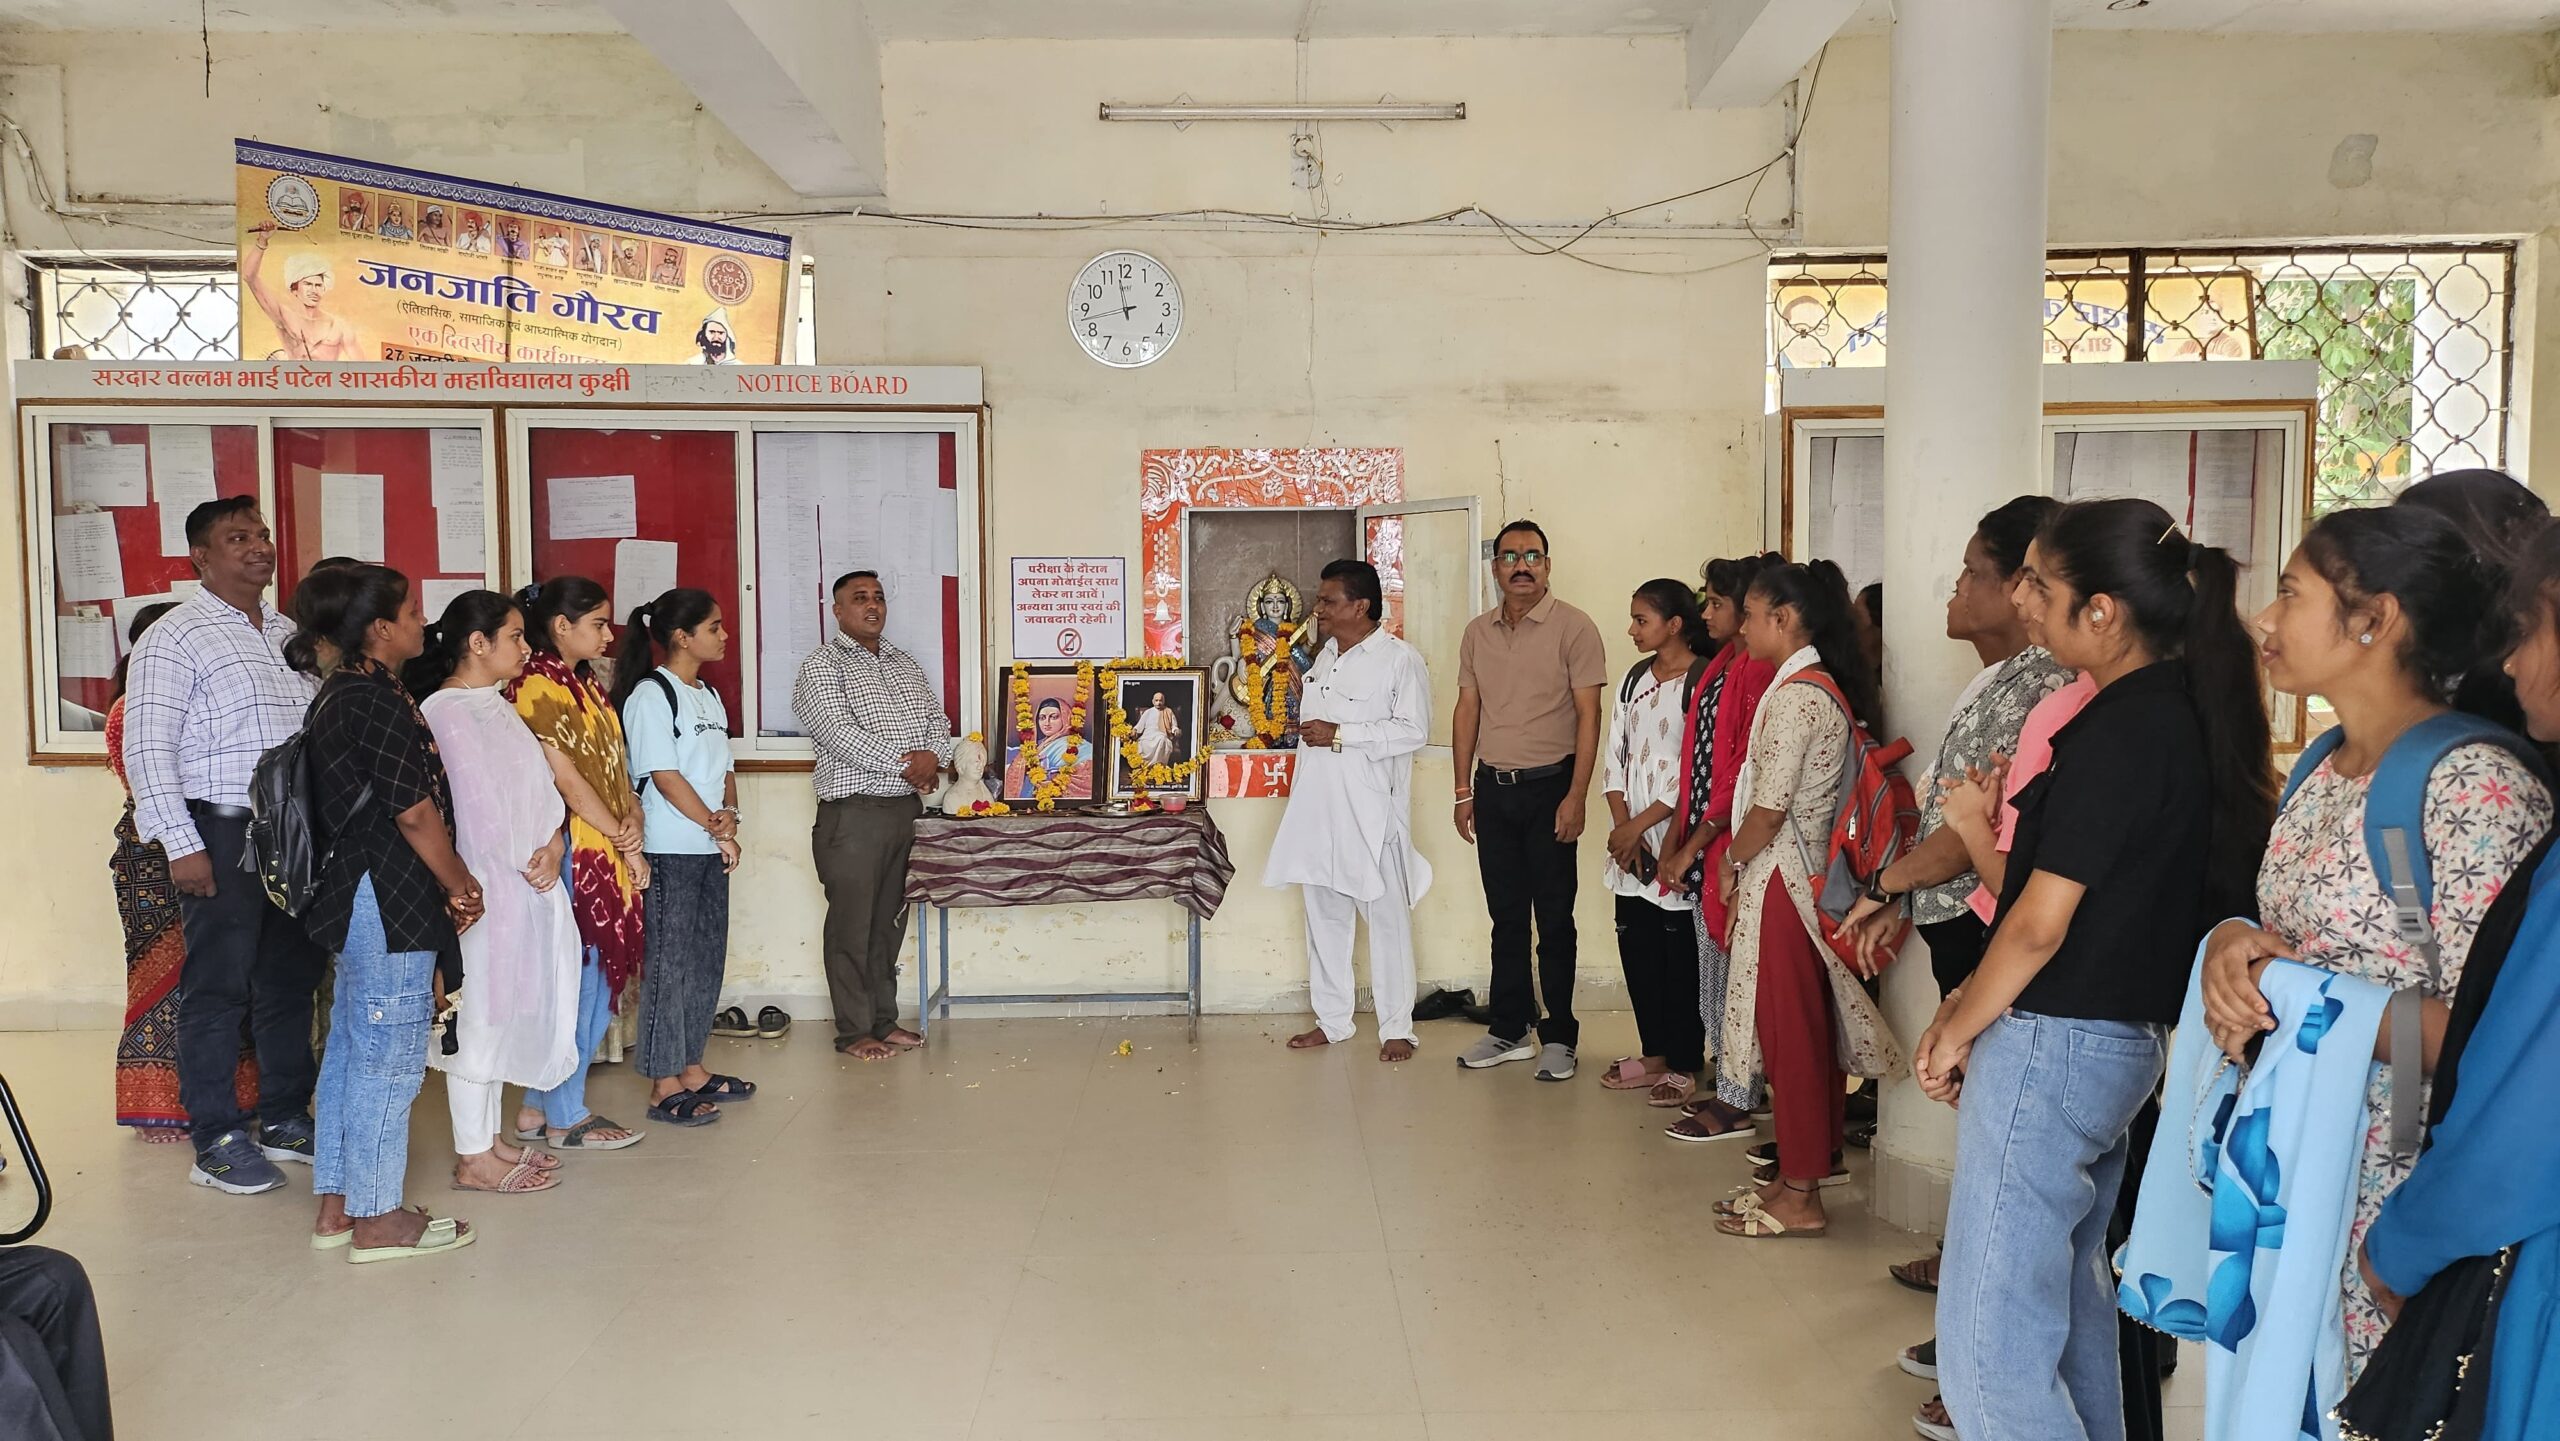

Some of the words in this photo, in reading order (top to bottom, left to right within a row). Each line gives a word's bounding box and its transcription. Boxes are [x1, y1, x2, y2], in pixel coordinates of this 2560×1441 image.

[1101, 270, 1113, 285] 11
[1118, 264, 1132, 279] 12
[1141, 268, 1147, 283] 1
[358, 259, 540, 314] जनजाति
[552, 290, 662, 334] गौरव
[1087, 284, 1103, 299] 10
[1154, 282, 1164, 297] 2
[1080, 302, 1090, 317] 9
[1161, 302, 1171, 317] 3
[460, 310, 505, 329] सामाजिक
[507, 320, 521, 333] एवं
[524, 323, 578, 341] आध्यात्मिक
[1088, 322, 1098, 337] 8
[1154, 322, 1164, 337] 4
[1103, 335, 1113, 350] 7
[1122, 341, 1132, 356] 6
[92, 369, 162, 387] सरदार
[166, 370, 232, 388] वल्लभ
[237, 365, 281, 390] भाई
[284, 365, 333, 388] पटेल
[339, 367, 437, 390] शासकीय
[444, 366, 573, 392] महाविद्यालय
[578, 365, 631, 395] कुक्षी
[737, 373, 823, 394] NOTICE
[829, 374, 908, 395] BOARD
[1028, 563, 1061, 573] परीक्षा
[1063, 563, 1075, 573] के
[1077, 563, 1108, 574] दौरान
[1018, 577, 1049, 586] अपना
[1051, 575, 1092, 587] मोबाईल
[1095, 577, 1119, 586] साथ
[1032, 588, 1058, 598] लेकर
[1061, 590, 1073, 598] ना
[1017, 602, 1053, 611] अन्यथा
[1056, 602, 1078, 611] आप
[1081, 600, 1103, 611] स्वयं
[1105, 600, 1121, 611] की
[1025, 613, 1077, 624] जवाबदारी
[1080, 613, 1107, 624] रहेगी
